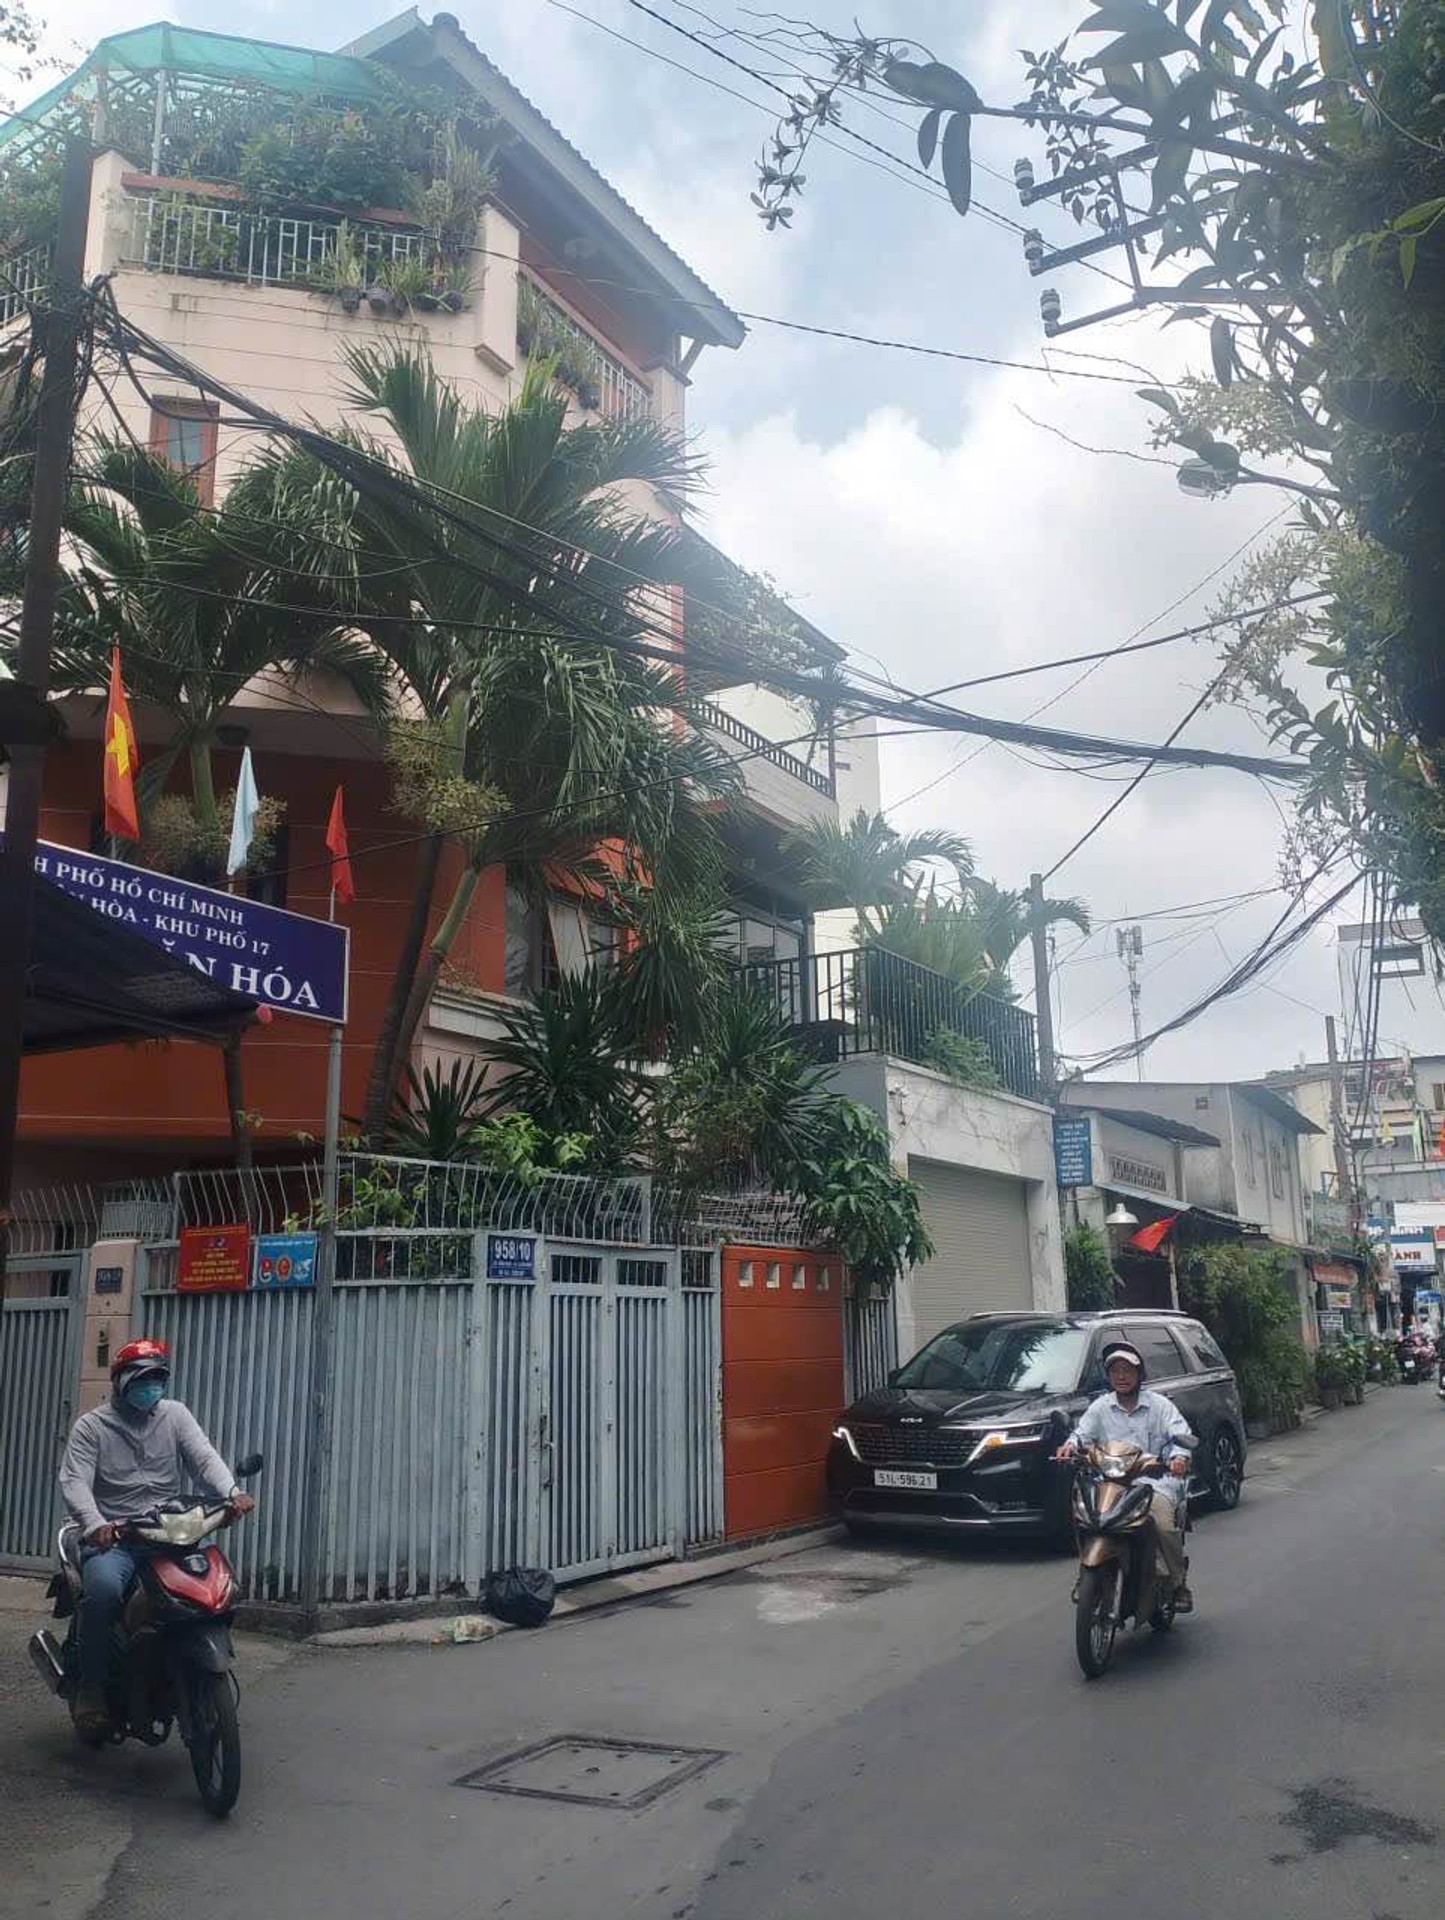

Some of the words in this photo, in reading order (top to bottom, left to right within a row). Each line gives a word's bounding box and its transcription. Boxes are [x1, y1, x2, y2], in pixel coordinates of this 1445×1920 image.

[56, 862, 105, 887] PHỐ
[110, 876, 142, 898] HỒ
[148, 888, 185, 910] CHÍ
[190, 899, 244, 926] MINH
[91, 897, 137, 923] HÒA
[155, 914, 199, 937] KHU
[205, 926, 247, 949] PHỐ
[252, 940, 270, 955] 17
[230, 963, 321, 1009] HÓA
